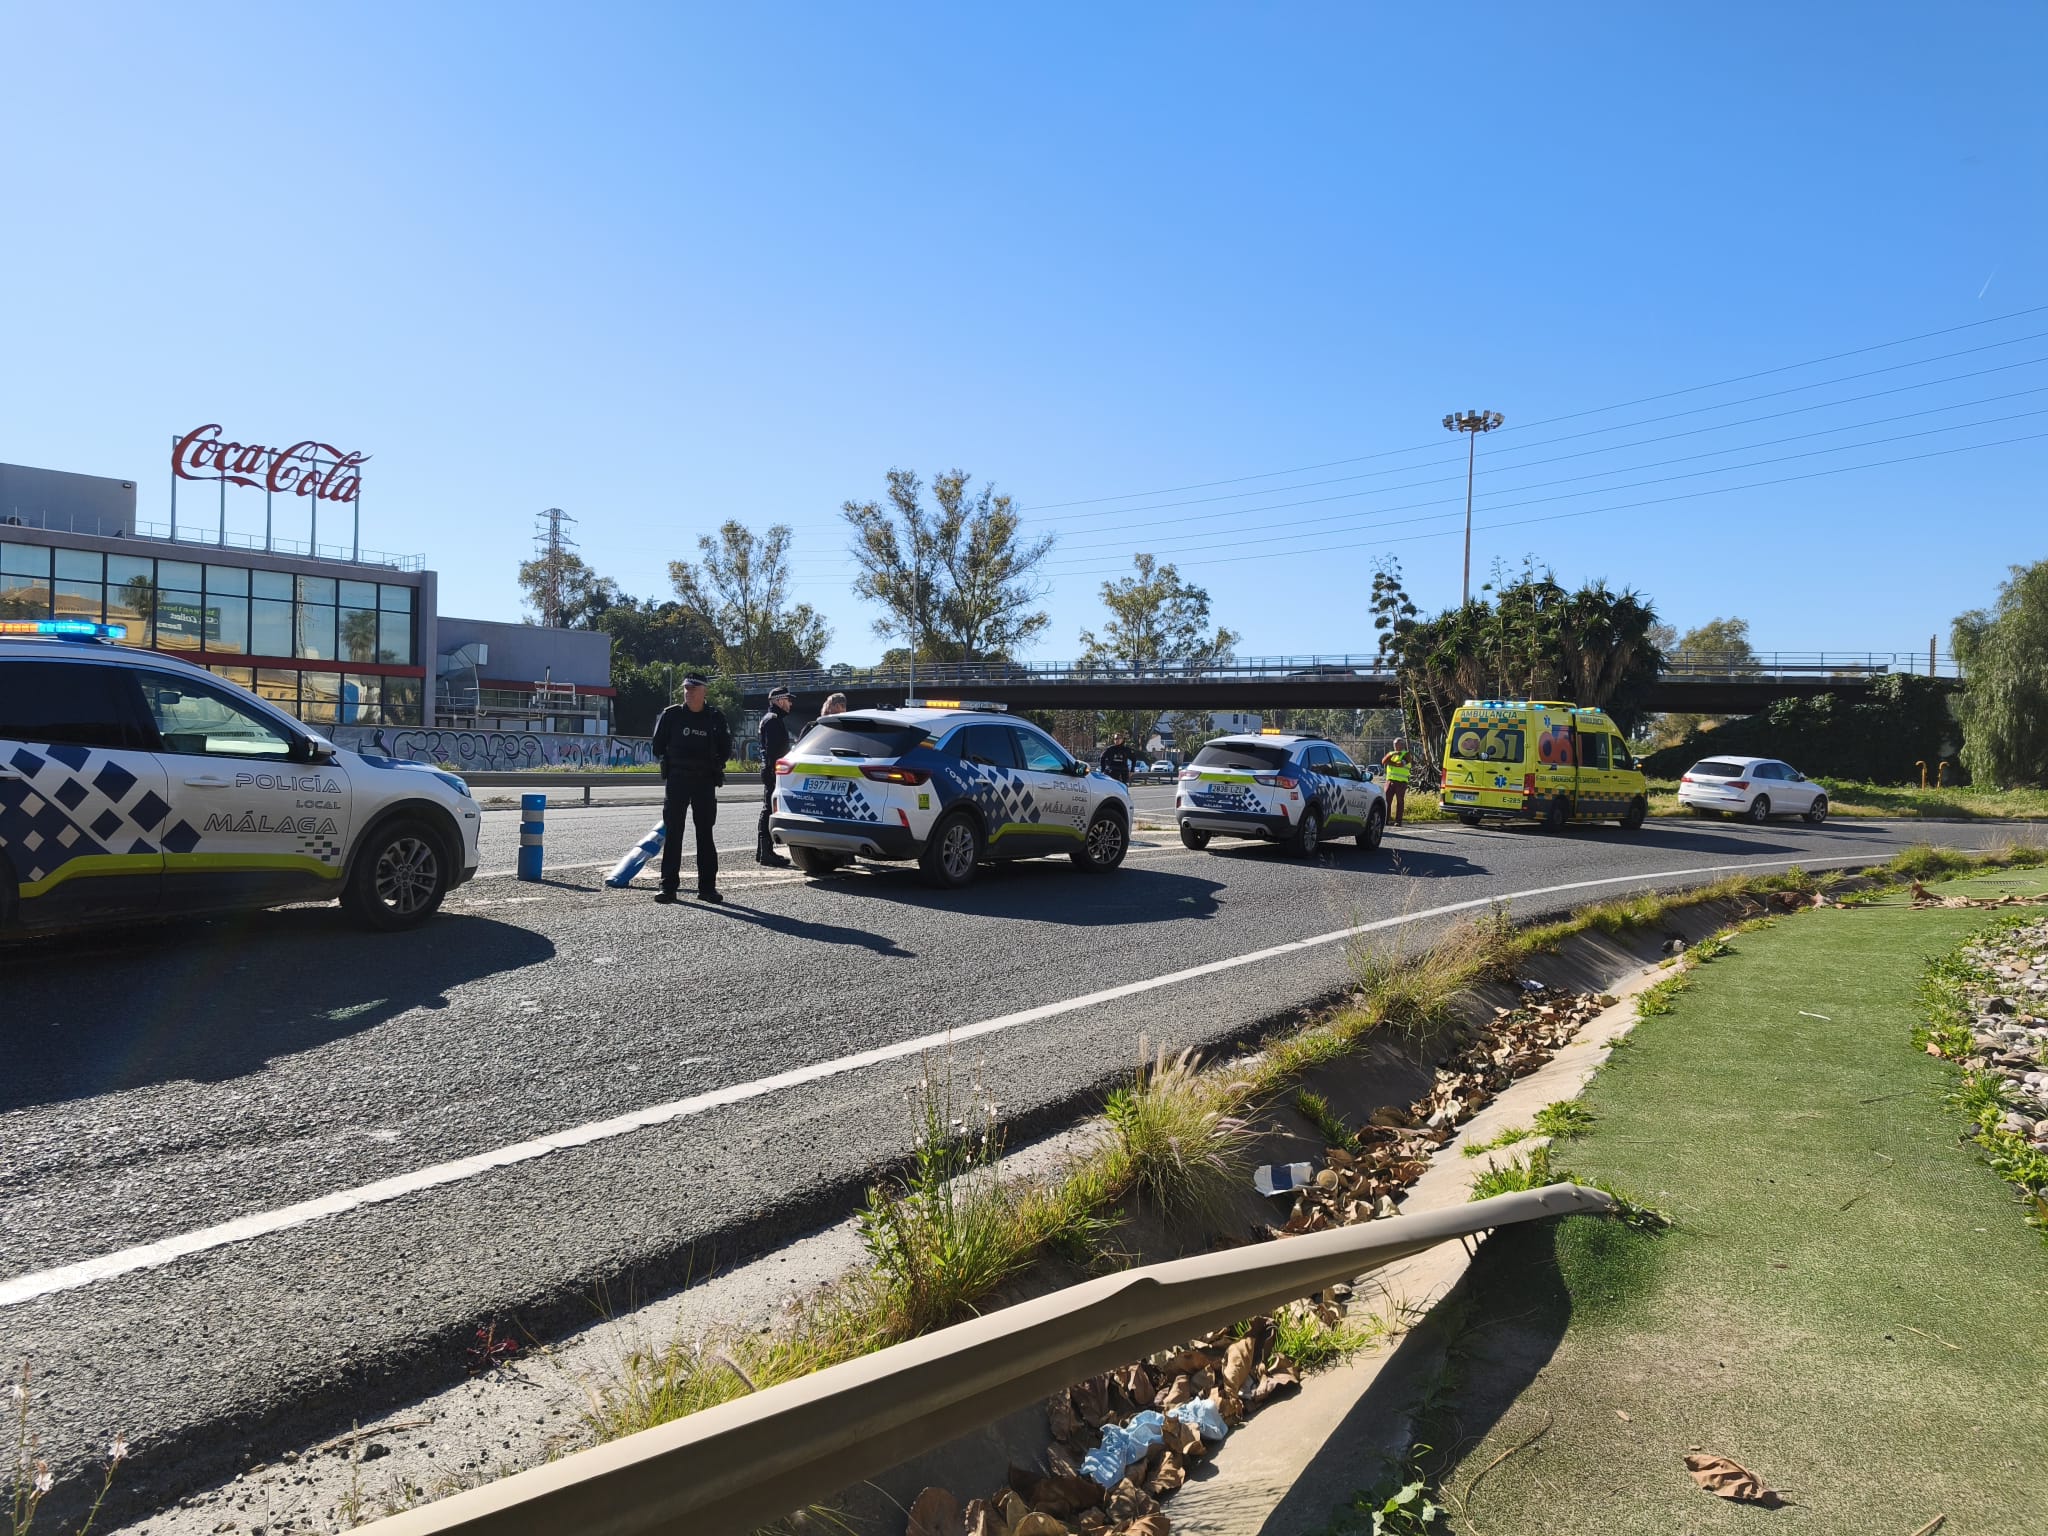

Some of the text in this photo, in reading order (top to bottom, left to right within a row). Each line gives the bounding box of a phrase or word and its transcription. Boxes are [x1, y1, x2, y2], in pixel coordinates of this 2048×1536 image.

[171, 423, 374, 503] Coca-Cola
[1461, 710, 1518, 719] AMBULANCIA
[1457, 729, 1518, 761] 061
[235, 773, 342, 793] POLICÍA
[1053, 781, 1088, 794] POLICÍA
[296, 799, 342, 810] LOCAL
[1041, 801, 1087, 817] MÁLAGA
[203, 810, 338, 835] MÁLAGA
